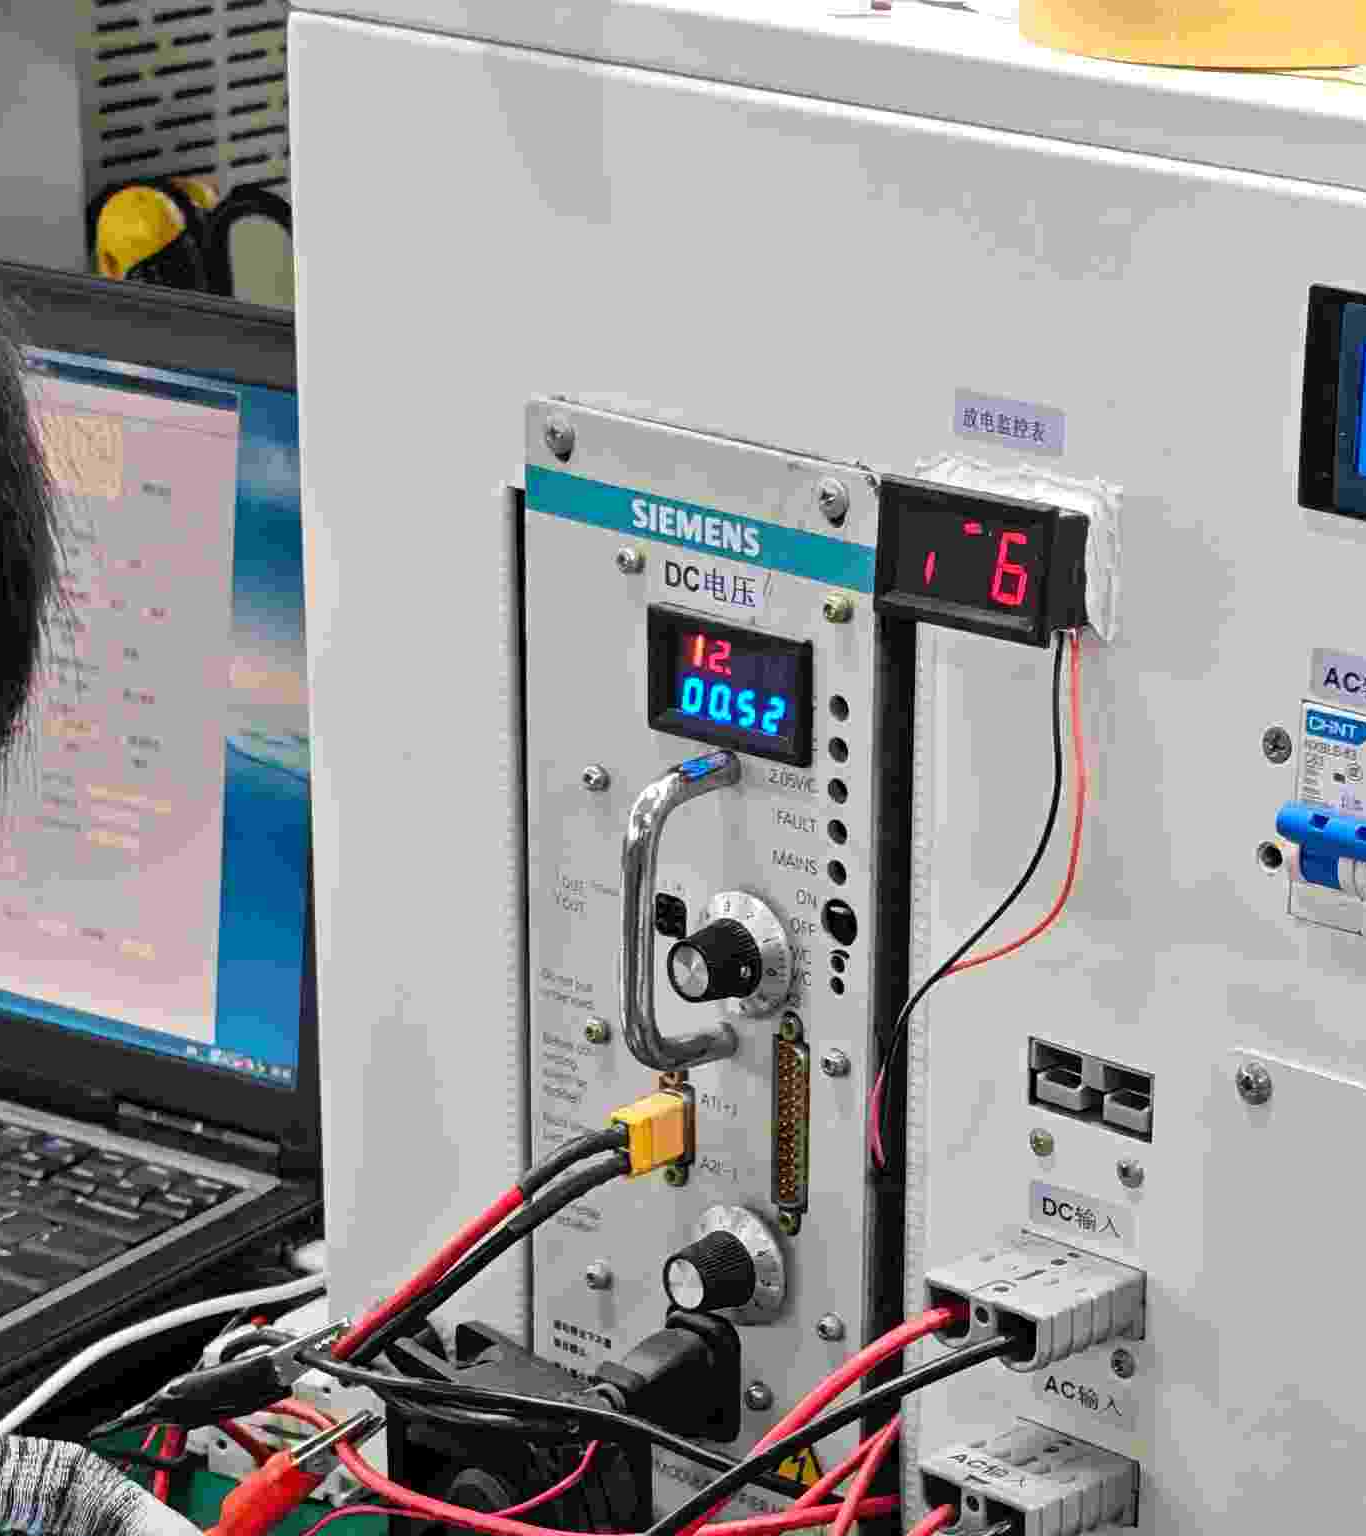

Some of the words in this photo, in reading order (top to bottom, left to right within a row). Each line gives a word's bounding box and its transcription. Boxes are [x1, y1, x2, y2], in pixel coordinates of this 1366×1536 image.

[962, 407, 1045, 443] 放电监控表
[631, 498, 762, 557] SIEMENS
[664, 560, 756, 608] DC电压
[772, 849, 818, 875] MAINS
[795, 887, 818, 908] ON
[789, 916, 818, 937] OFF
[1042, 1197, 1123, 1239] DC输入
